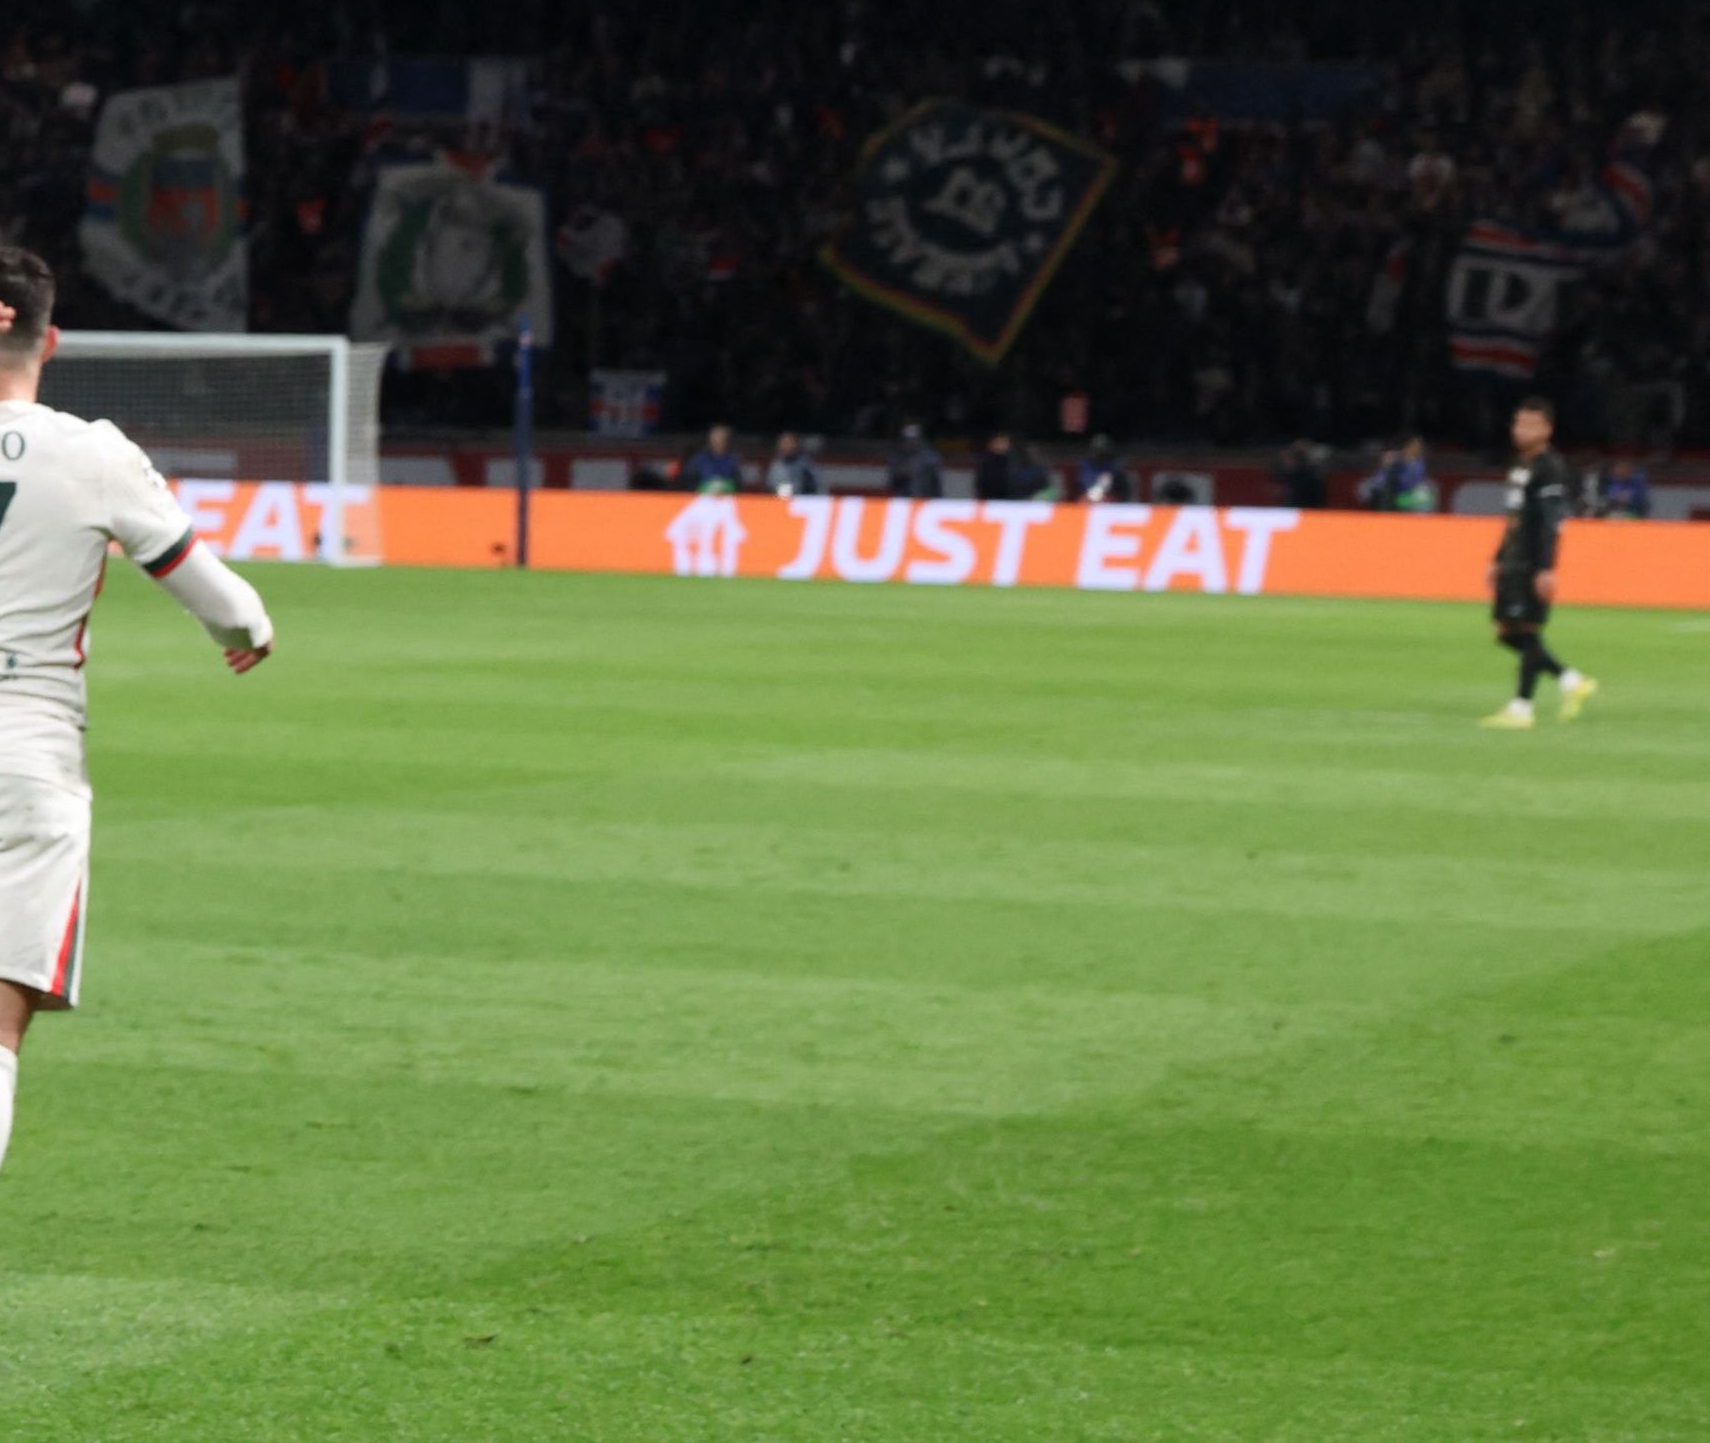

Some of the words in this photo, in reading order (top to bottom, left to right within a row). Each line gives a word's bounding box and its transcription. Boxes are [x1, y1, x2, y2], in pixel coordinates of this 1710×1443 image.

[181, 477, 371, 562] EAT
[776, 495, 1055, 588] JUST
[1077, 502, 1301, 595] EAT
